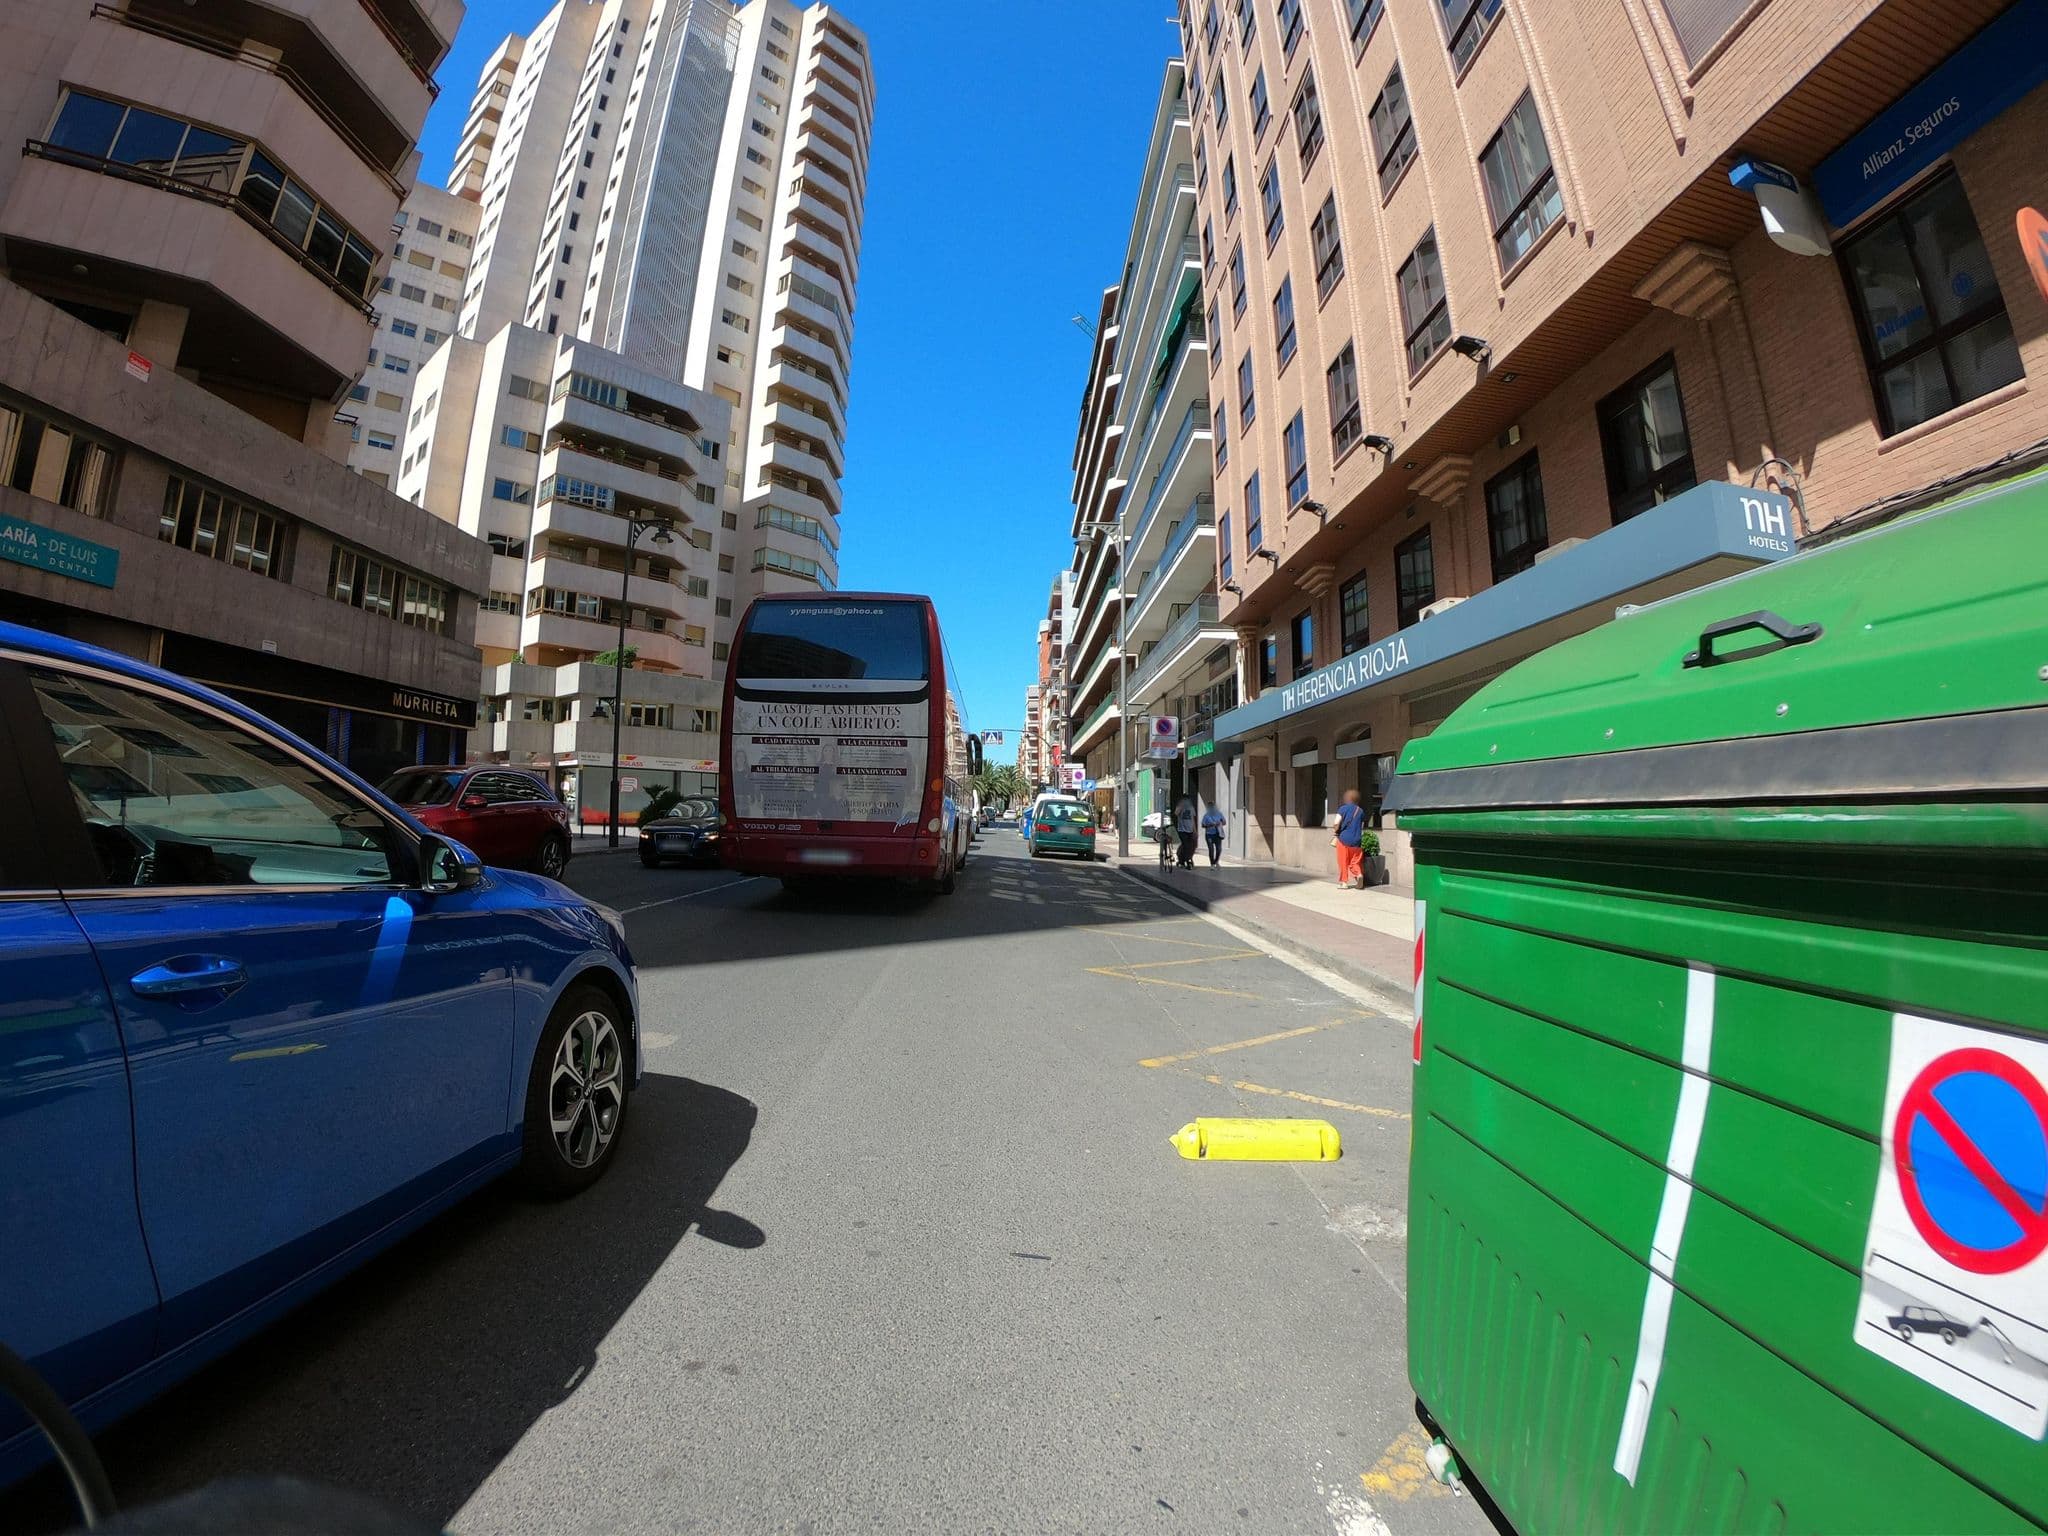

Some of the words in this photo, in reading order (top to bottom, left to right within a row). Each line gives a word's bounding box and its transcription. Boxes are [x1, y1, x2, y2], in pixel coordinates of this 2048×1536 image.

[1862, 139, 1906, 180] Allianz
[1904, 96, 1960, 145] Seguros
[0, 526, 38, 548] ARÍA
[70, 545, 98, 565] LUIS
[1748, 535, 1789, 552] HOTELS
[49, 557, 96, 577] DENTAL
[1297, 660, 1357, 706] HERENCIA
[1359, 637, 1409, 682] RIOJA
[392, 692, 458, 718] MURRIETA
[758, 704, 812, 715] ALCASTE
[847, 705, 902, 716] FUENTES
[758, 716, 778, 728] UN
[781, 716, 823, 729] COLE
[826, 717, 901, 730] ABIERTO:
